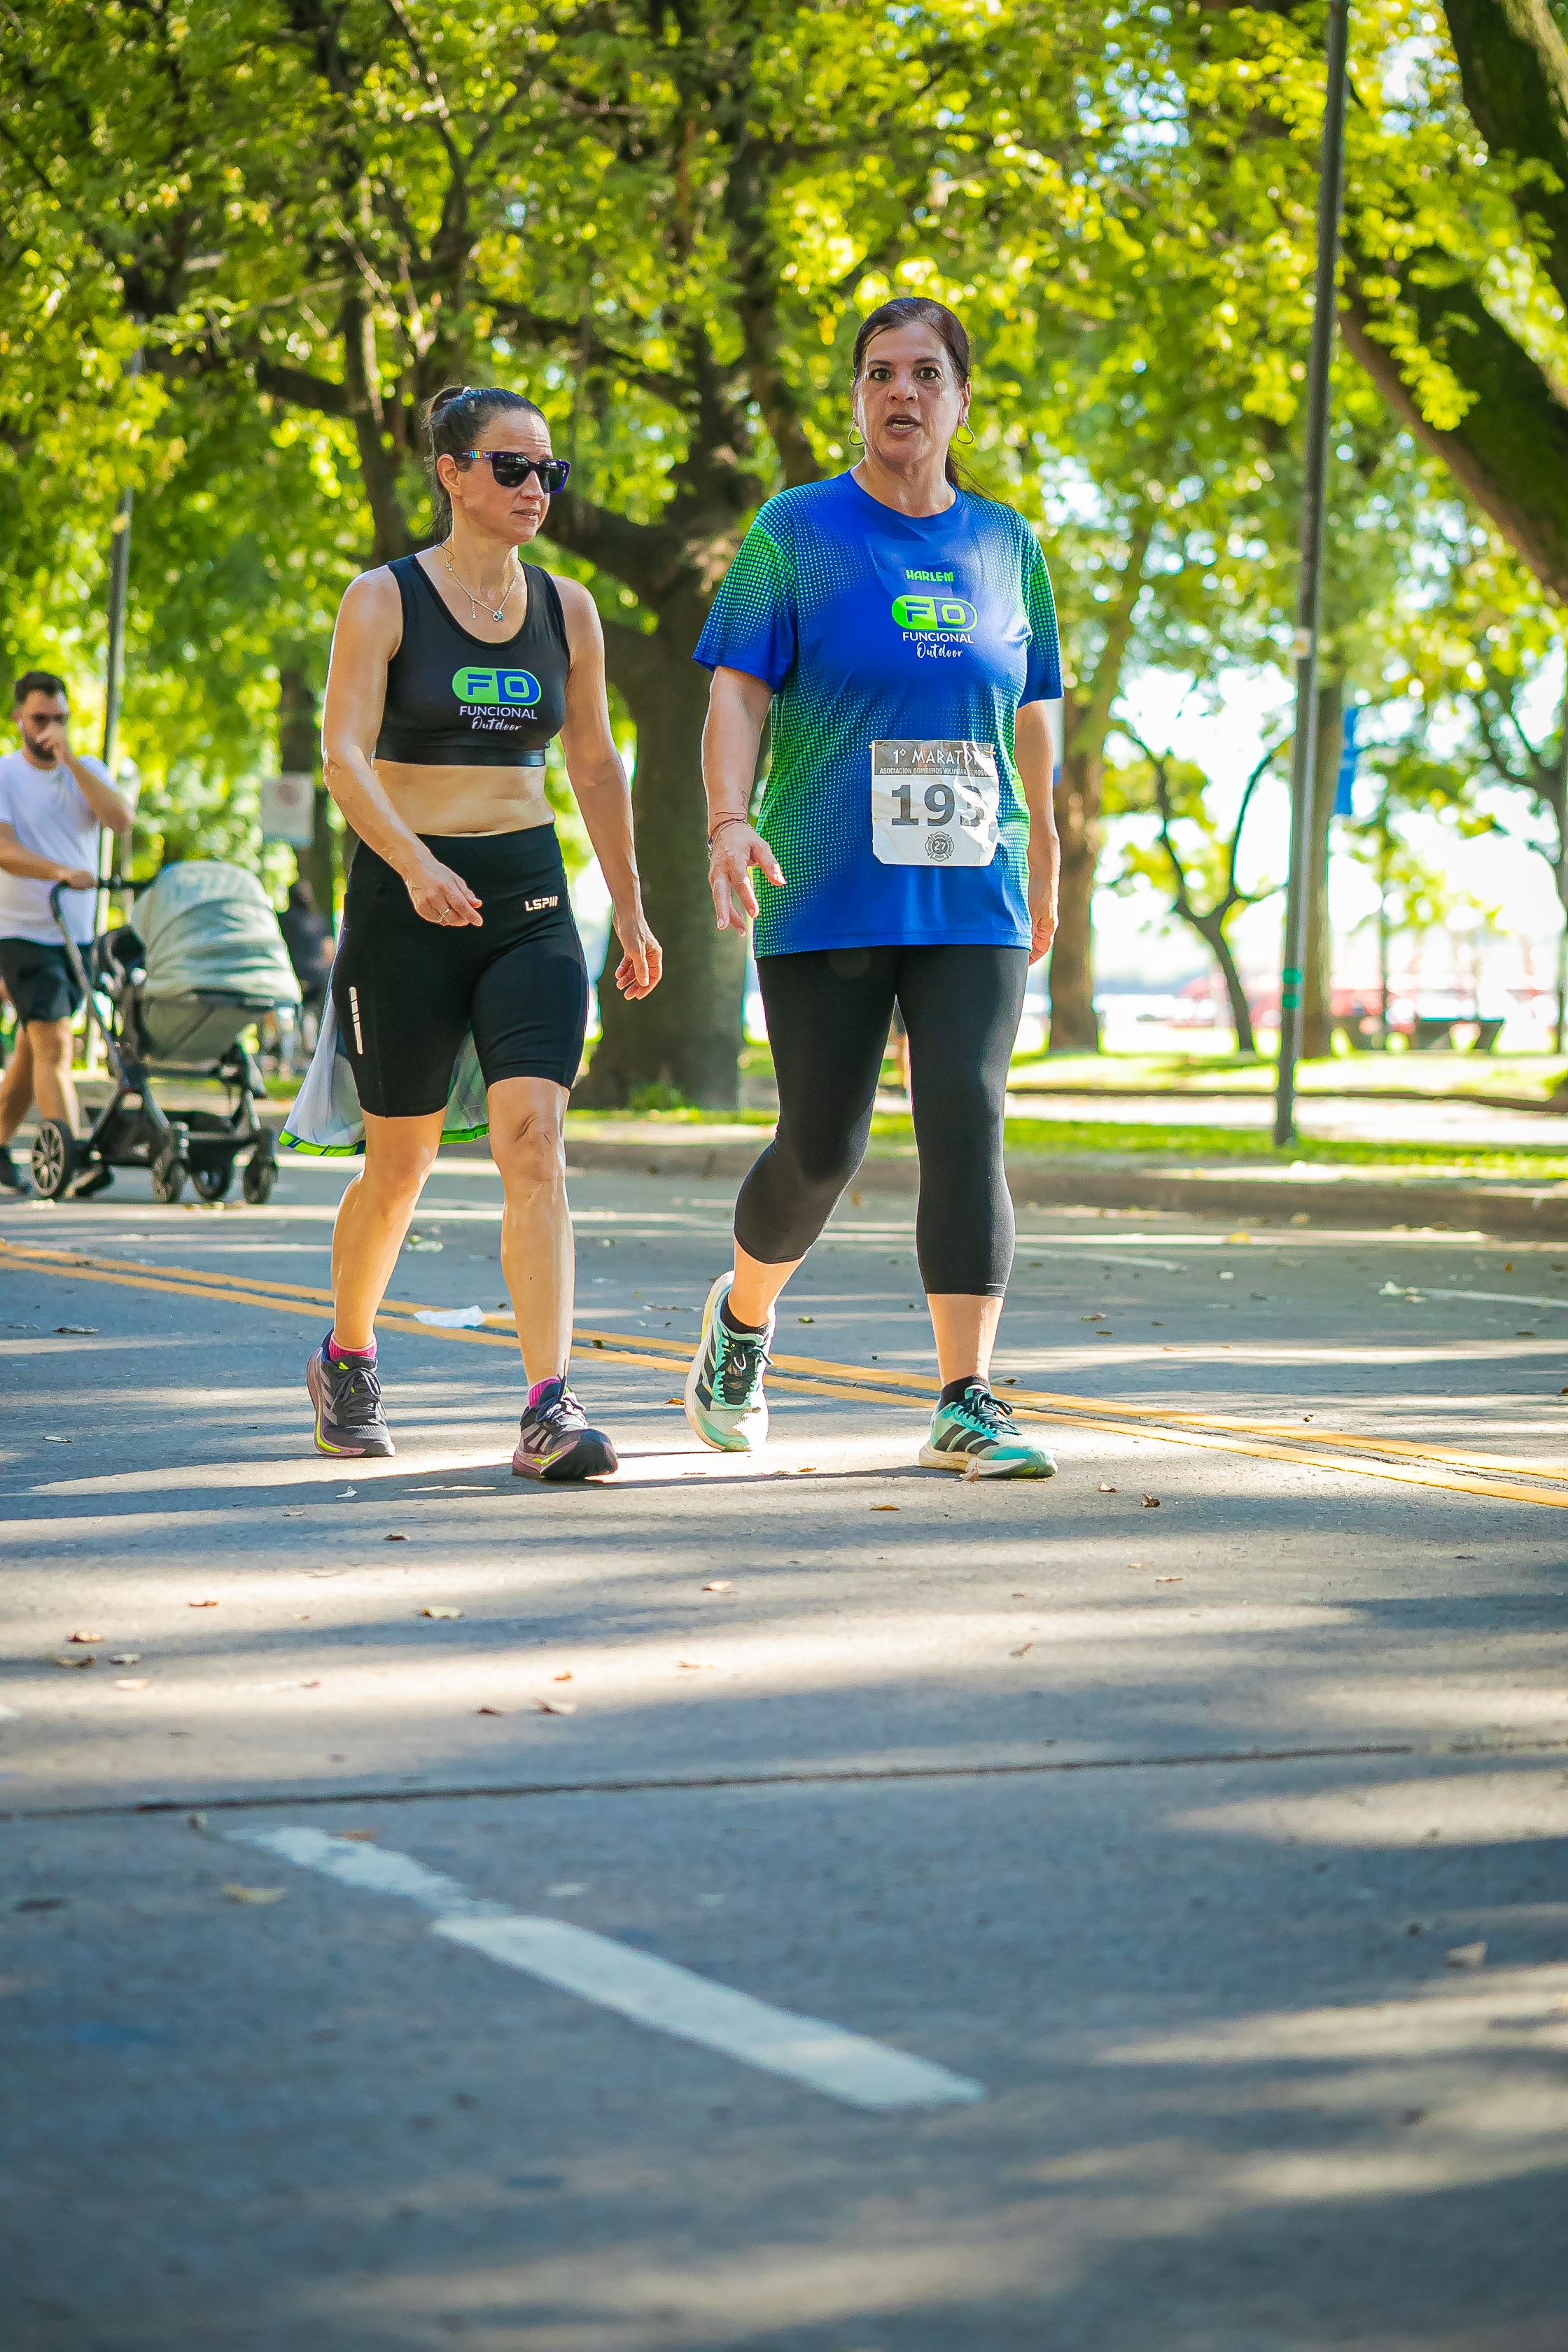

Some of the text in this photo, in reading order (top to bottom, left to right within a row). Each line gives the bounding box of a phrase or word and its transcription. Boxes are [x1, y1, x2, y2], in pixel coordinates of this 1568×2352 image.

[905, 569, 954, 582] HARLEM
[902, 631, 974, 644] FUNCIONAL
[916, 641, 963, 659] Outdoor
[459, 706, 538, 720] FUNCIONAL
[471, 715, 522, 731] Outdoor
[943, 767, 974, 776] VOLUNTARS
[934, 840, 946, 851] 27
